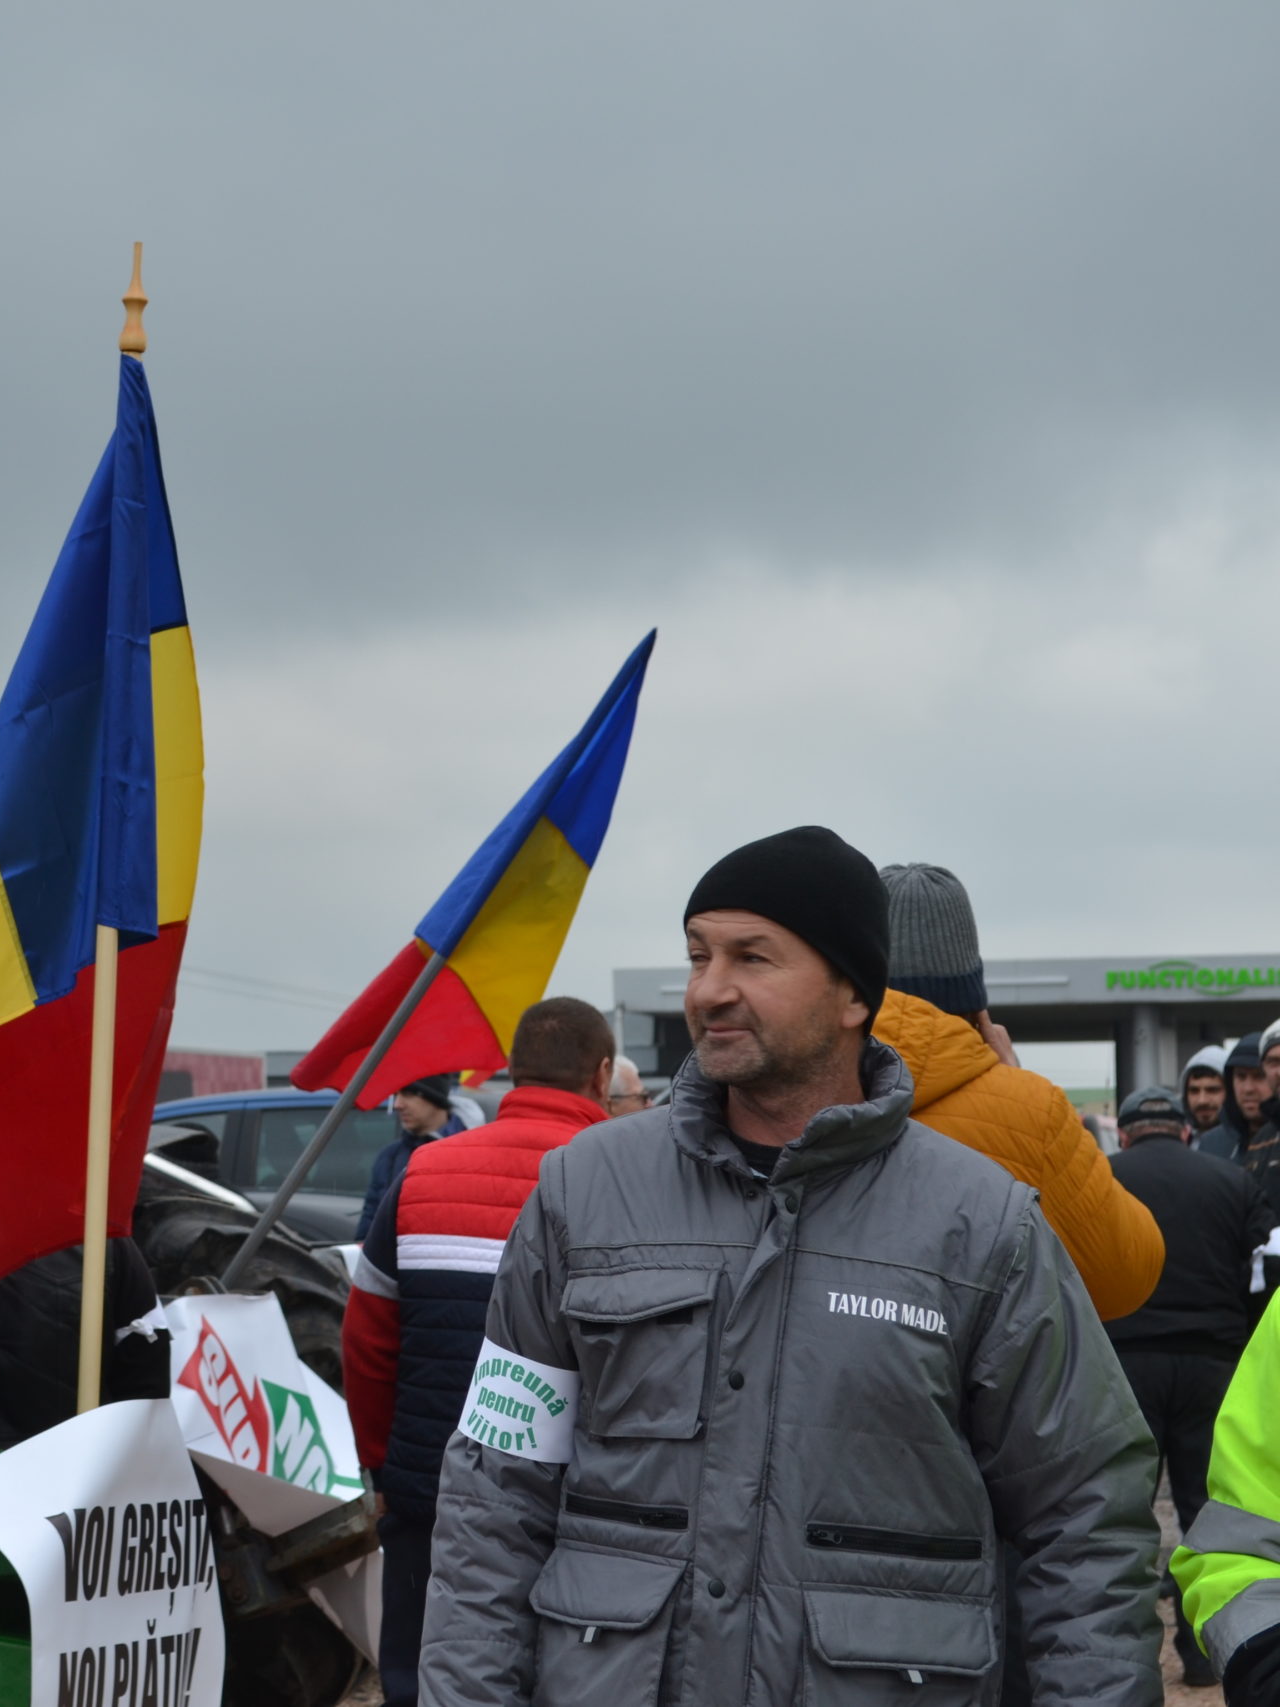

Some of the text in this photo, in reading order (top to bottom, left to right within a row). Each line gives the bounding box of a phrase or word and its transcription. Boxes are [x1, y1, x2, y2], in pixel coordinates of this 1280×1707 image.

[1106, 966, 1280, 990] FUNCTIONALI
[827, 1291, 949, 1335] TAYLOR MADE
[477, 1386, 536, 1424] pentru
[466, 1408, 537, 1451] viitor!
[45, 1505, 115, 1602] VOI
[58, 1646, 106, 1707] NOI
